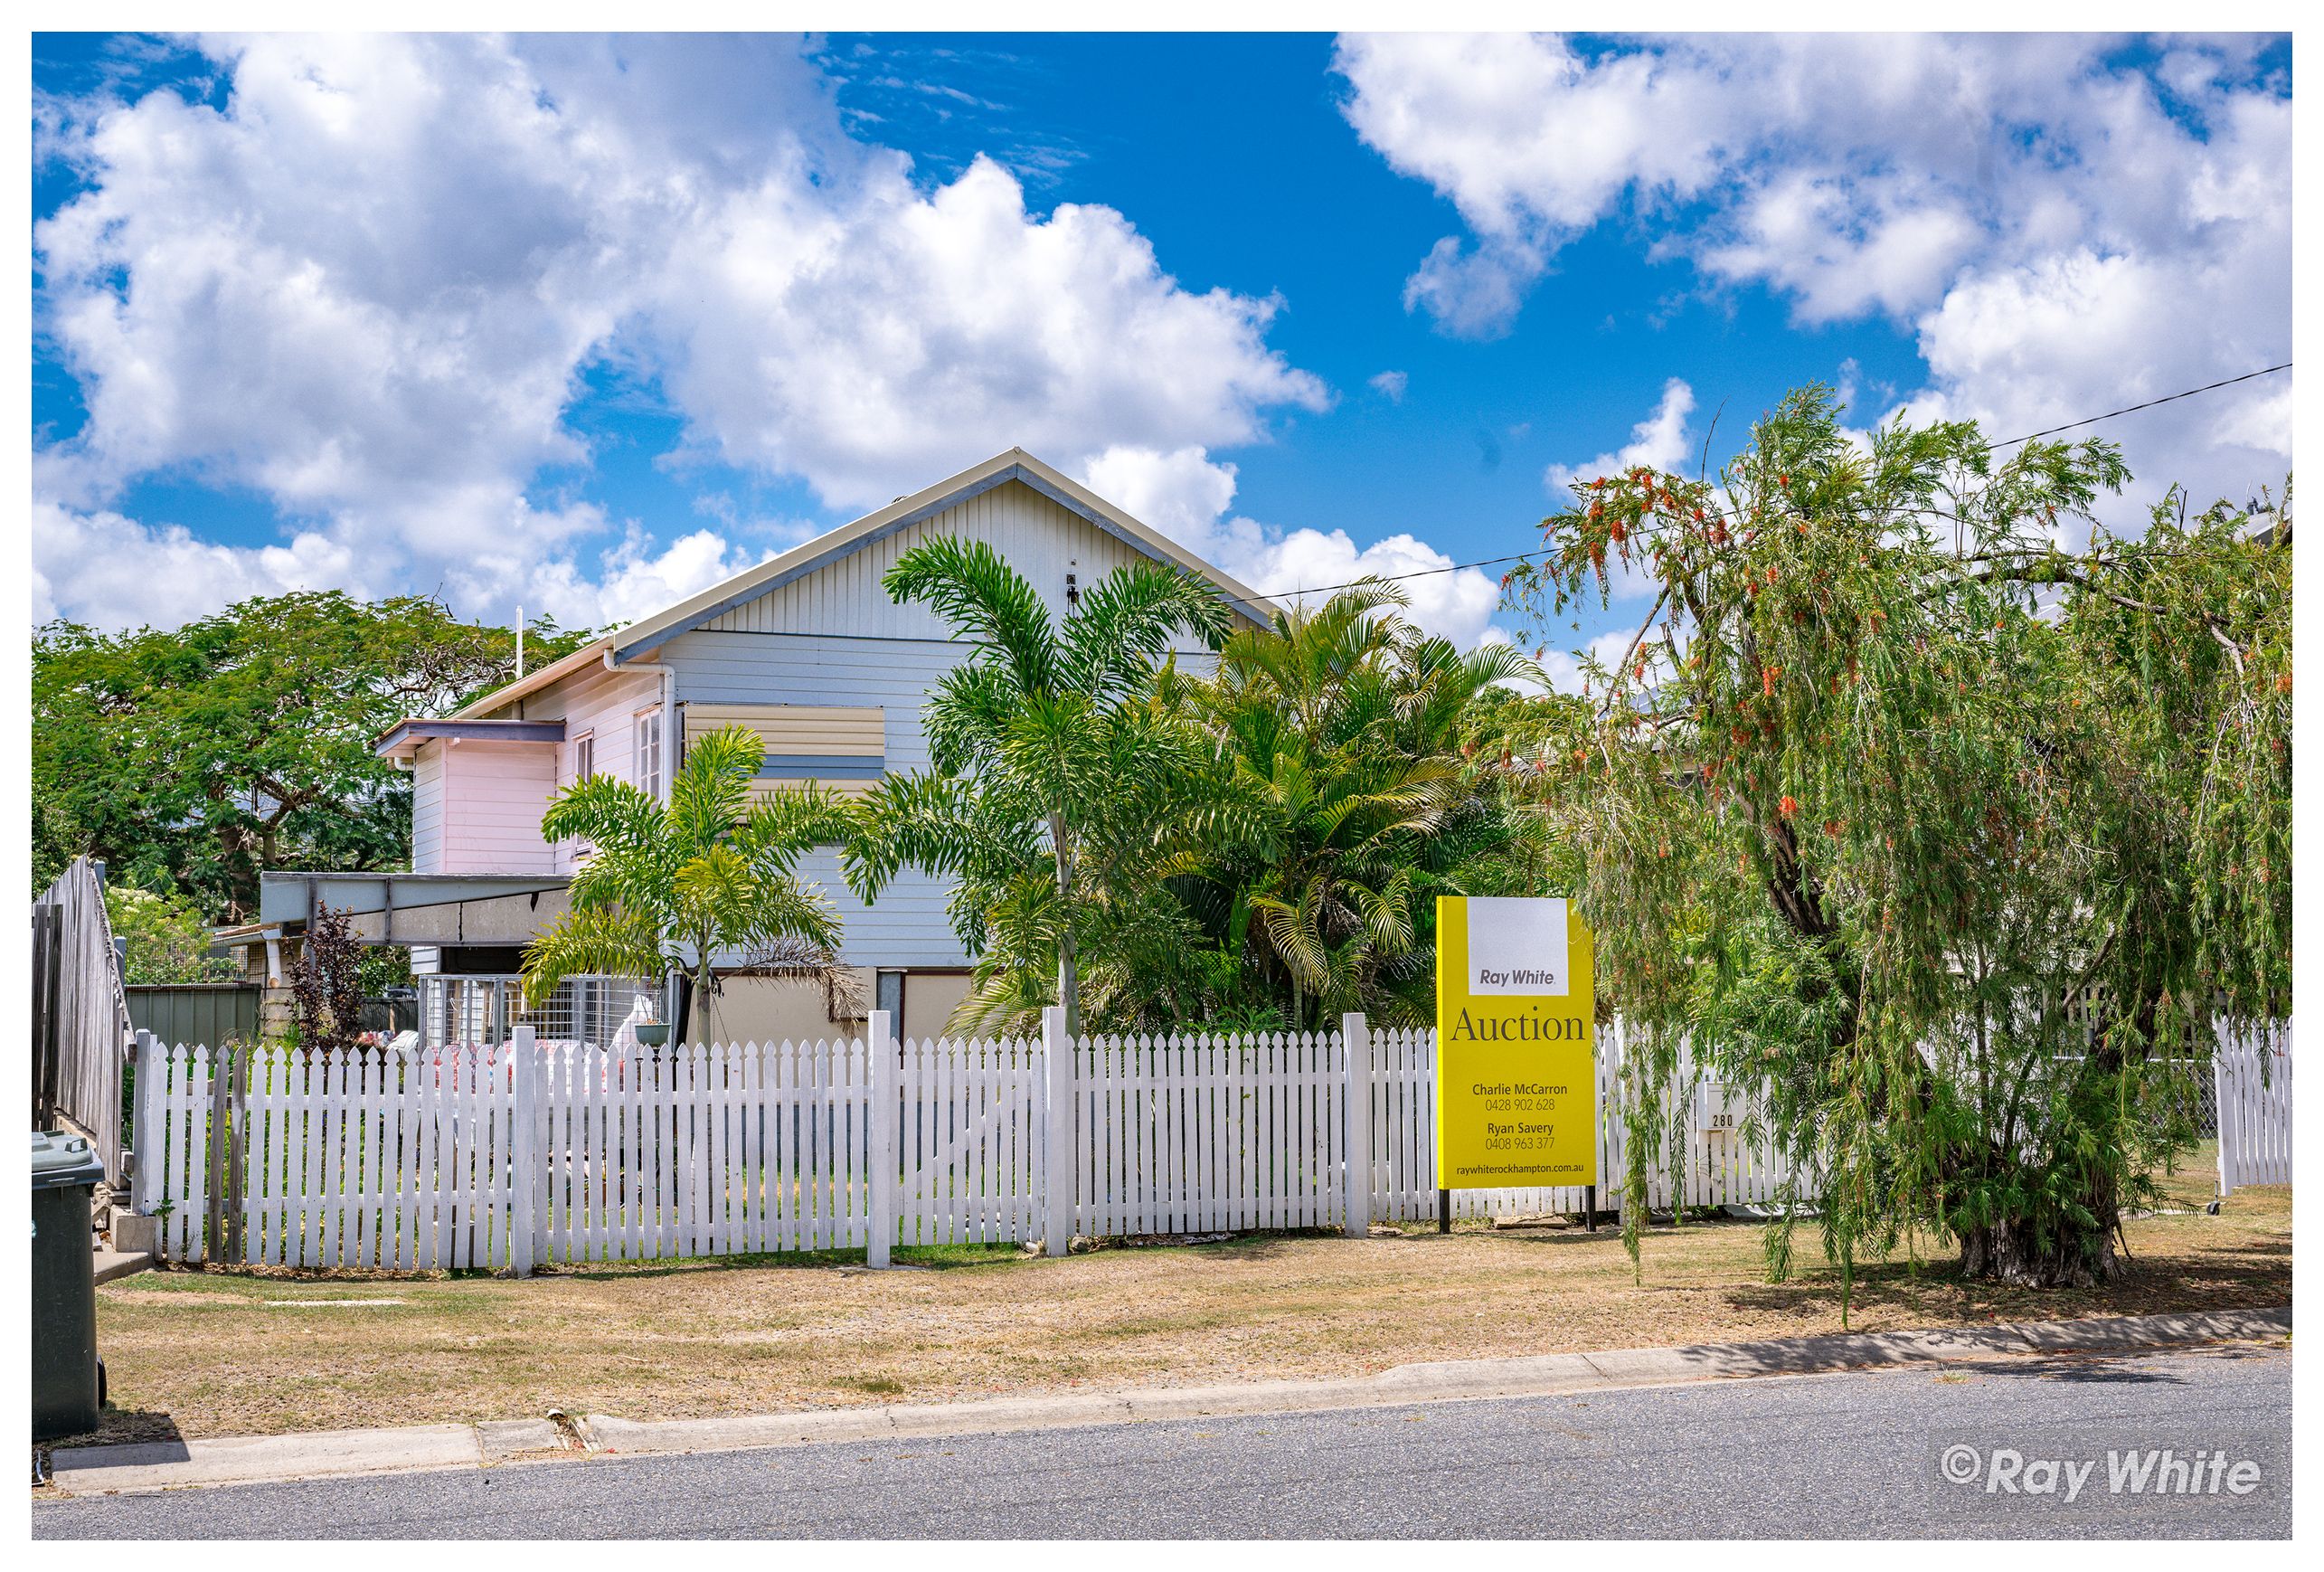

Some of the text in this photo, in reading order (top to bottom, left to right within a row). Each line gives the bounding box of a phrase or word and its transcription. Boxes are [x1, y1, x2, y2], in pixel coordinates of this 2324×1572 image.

[1479, 969, 1554, 987] Ray White
[1450, 1006, 1585, 1041] Auction
[1472, 1083, 1567, 1095] Charlie McCarron
[1485, 1098, 1555, 1112] 0428 902 628
[1713, 1114, 1733, 1127] 280
[1488, 1122, 1554, 1137] Ryan Savery
[1485, 1137, 1555, 1151] 0408 963 377
[1456, 1163, 1584, 1177] raywhiterockhampton.com.au
